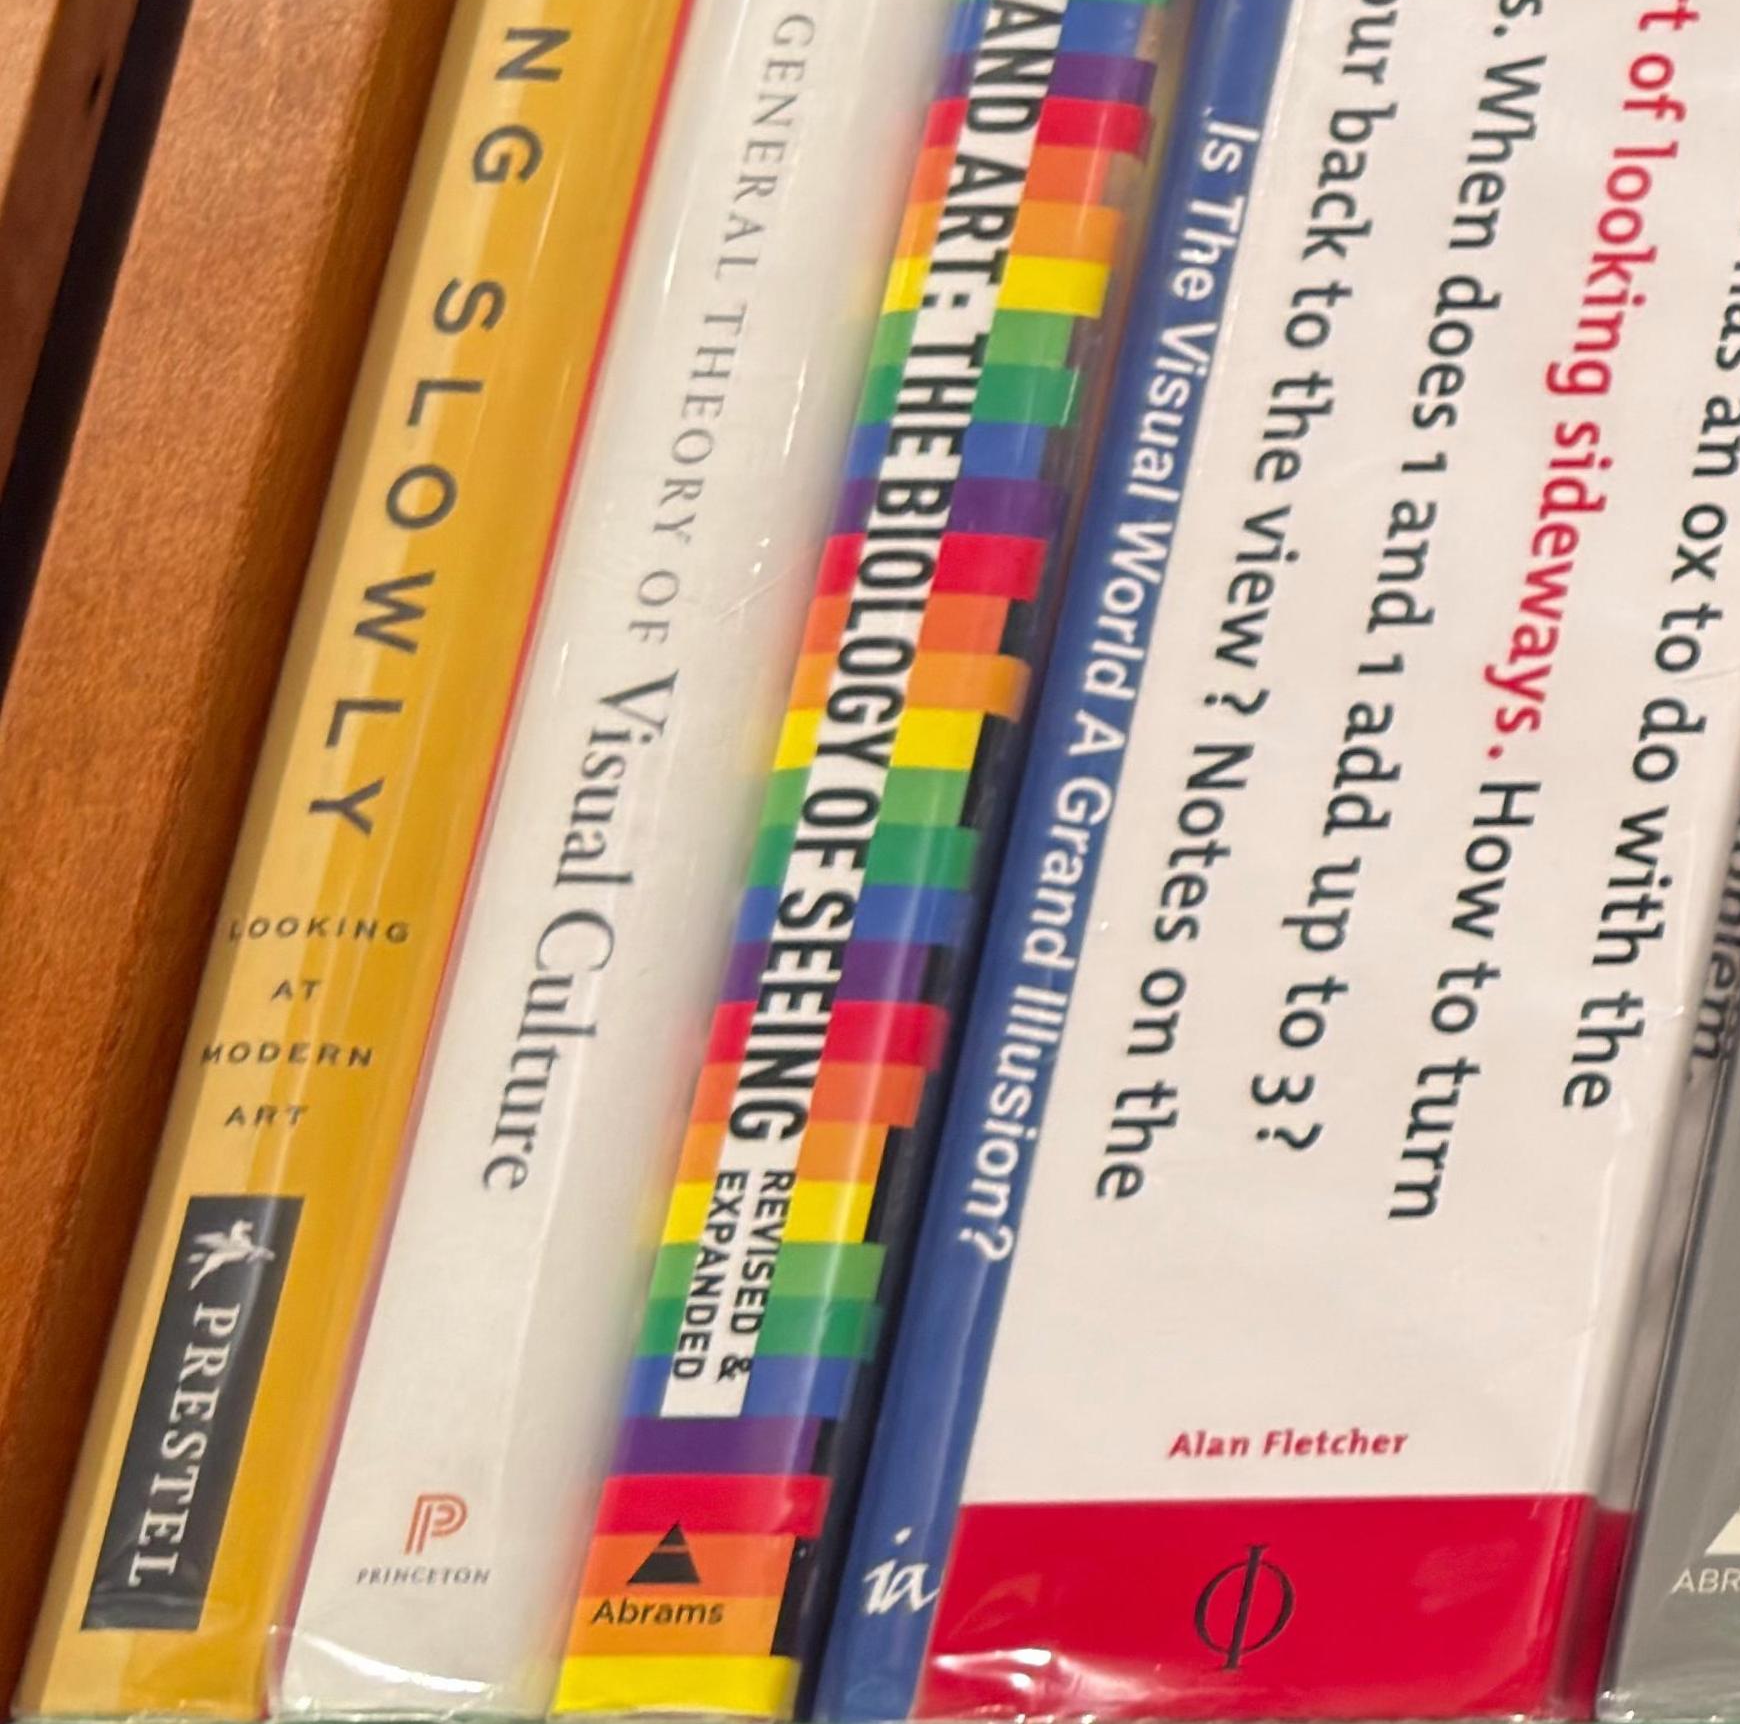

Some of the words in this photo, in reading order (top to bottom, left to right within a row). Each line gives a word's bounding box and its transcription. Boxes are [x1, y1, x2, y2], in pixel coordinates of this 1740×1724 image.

[704, 6, 814, 282] GENERAL
[1622, 54, 1687, 122] of
[1547, 138, 1679, 398] looking
[651, 303, 746, 544] THEORY
[884, 332, 987, 465] THE
[309, 277, 505, 837] SLOWLY
[629, 572, 680, 644] OF
[816, 473, 949, 767] BIOLOGY
[1483, 418, 1612, 759] sideways.
[556, 669, 680, 890] Visual
[795, 789, 881, 883] OF
[228, 918, 411, 944] LOOKING
[1449, 781, 1541, 942] How
[200, 1042, 374, 1069] MODERN
[271, 978, 321, 1001] AT
[484, 907, 616, 1193] Culture
[728, 887, 860, 1147] SEEING
[1430, 962, 1500, 1037] to
[224, 1104, 309, 1127] ART
[1388, 1054, 1481, 1221] turn
[673, 1170, 749, 1381] EXPANDED
[729, 1170, 795, 1334] REVISED
[129, 1305, 239, 1588] PRESTEL
[719, 1354, 753, 1383] &
[1168, 1431, 1252, 1459] Alan
[1264, 1427, 1408, 1458] Fletcher
[356, 1566, 490, 1588] PRINCETON
[593, 1599, 725, 1628] Abrams
